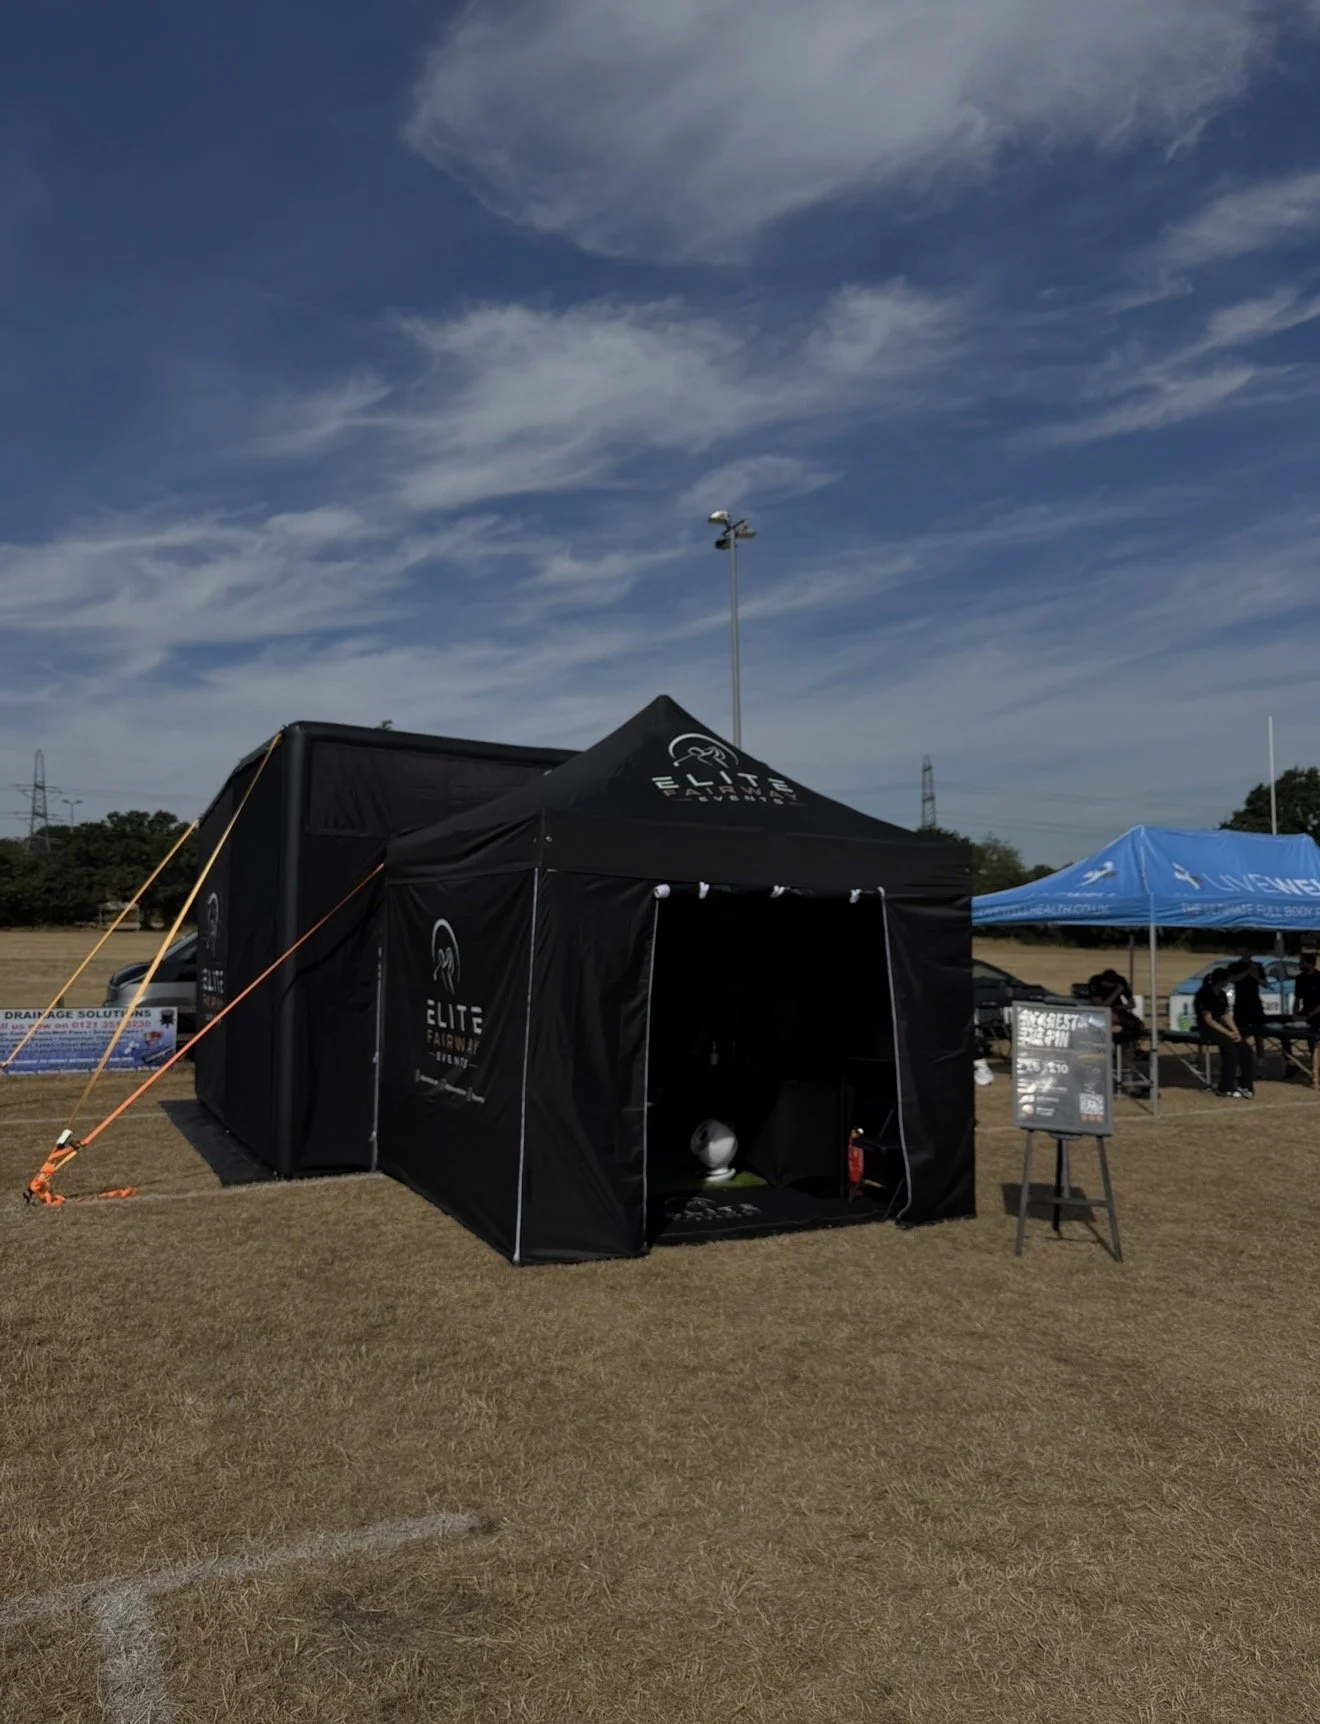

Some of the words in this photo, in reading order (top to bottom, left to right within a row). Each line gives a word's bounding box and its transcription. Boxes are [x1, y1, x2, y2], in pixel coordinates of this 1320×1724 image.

[651, 770, 794, 794] ELITE
[662, 785, 797, 801] FAIRWAY
[698, 795, 784, 805] EVENTS
[426, 998, 483, 1035] ELITE
[426, 1029, 480, 1056] FAIRWAY
[436, 1050, 468, 1069] EVENTS
